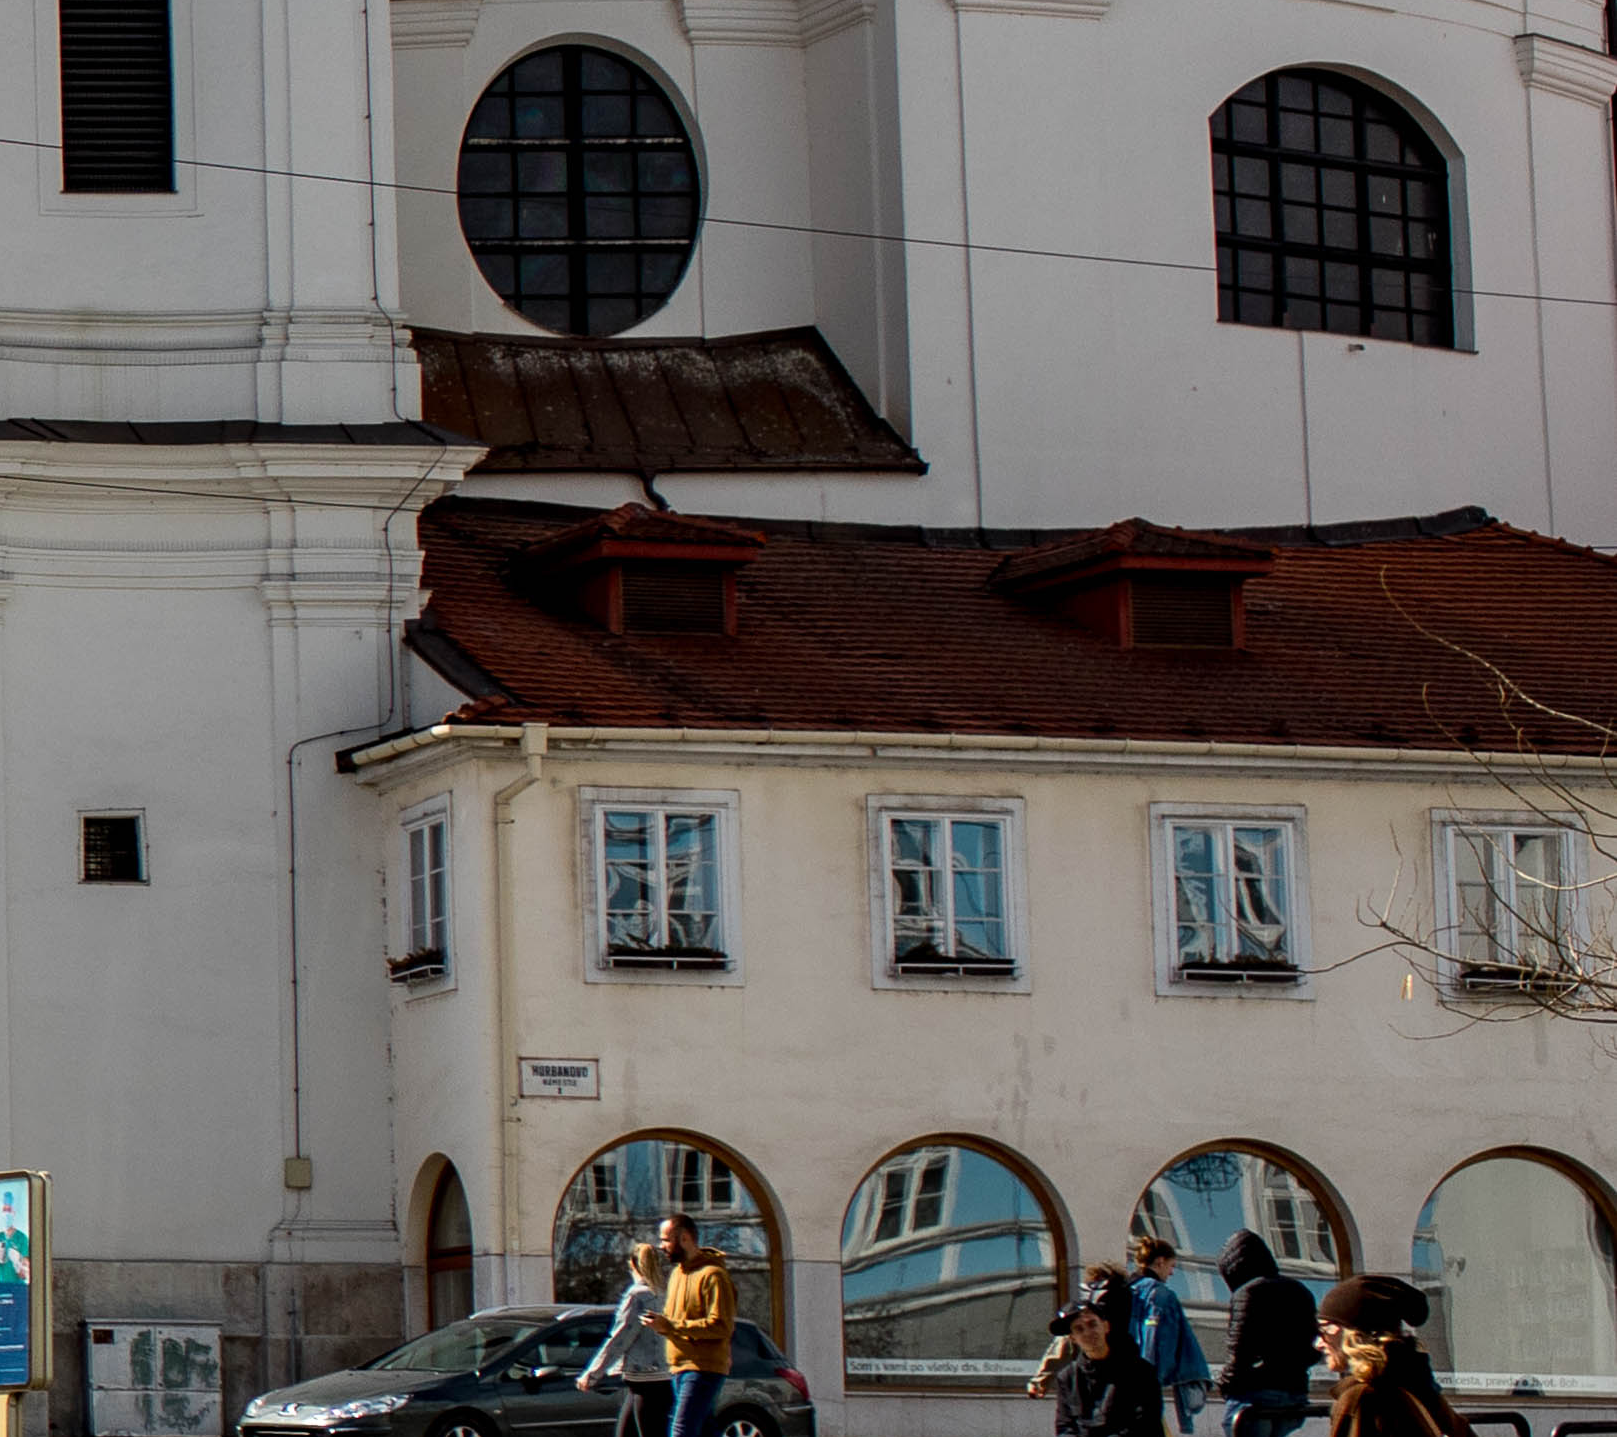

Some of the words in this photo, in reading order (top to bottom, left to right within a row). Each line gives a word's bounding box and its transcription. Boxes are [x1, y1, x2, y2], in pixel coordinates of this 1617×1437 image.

[532, 1065, 588, 1078] HURBANOVO
[851, 1363, 872, 1372] Som
[1436, 1377, 1453, 1386] om
